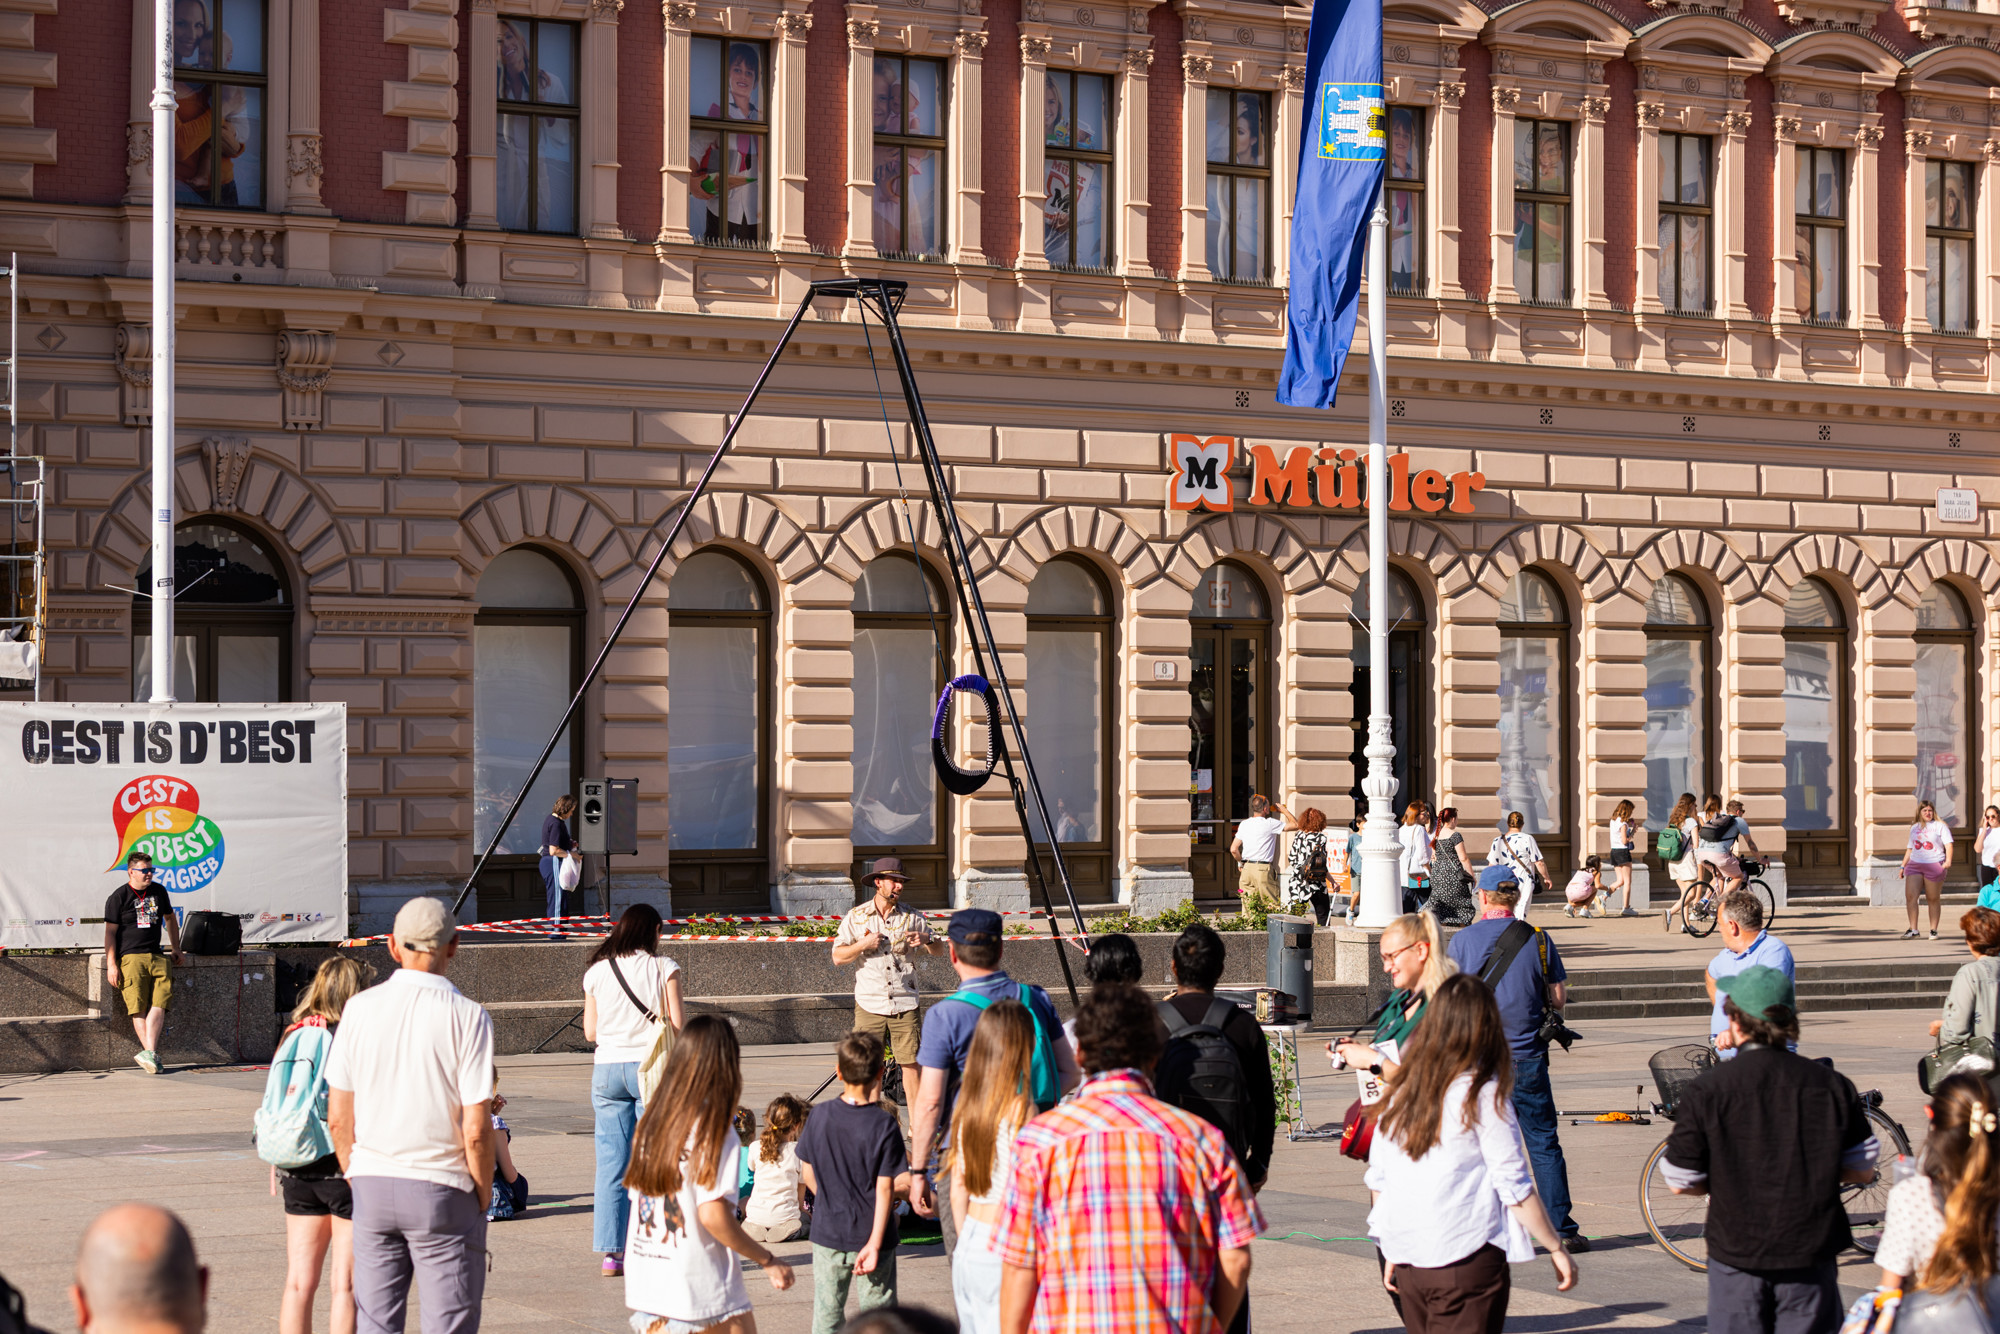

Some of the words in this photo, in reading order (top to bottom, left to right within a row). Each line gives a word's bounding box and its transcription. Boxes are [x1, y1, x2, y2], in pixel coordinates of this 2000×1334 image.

[1185, 456, 1218, 490] M
[1161, 662, 1168, 675] 8
[22, 720, 124, 764] CEST
[133, 720, 173, 764] IS
[179, 720, 316, 764] D'BEST
[120, 778, 189, 813] CEST
[145, 808, 173, 831] IS
[136, 819, 214, 863] D'BEST
[151, 856, 220, 889] ZAGREB
